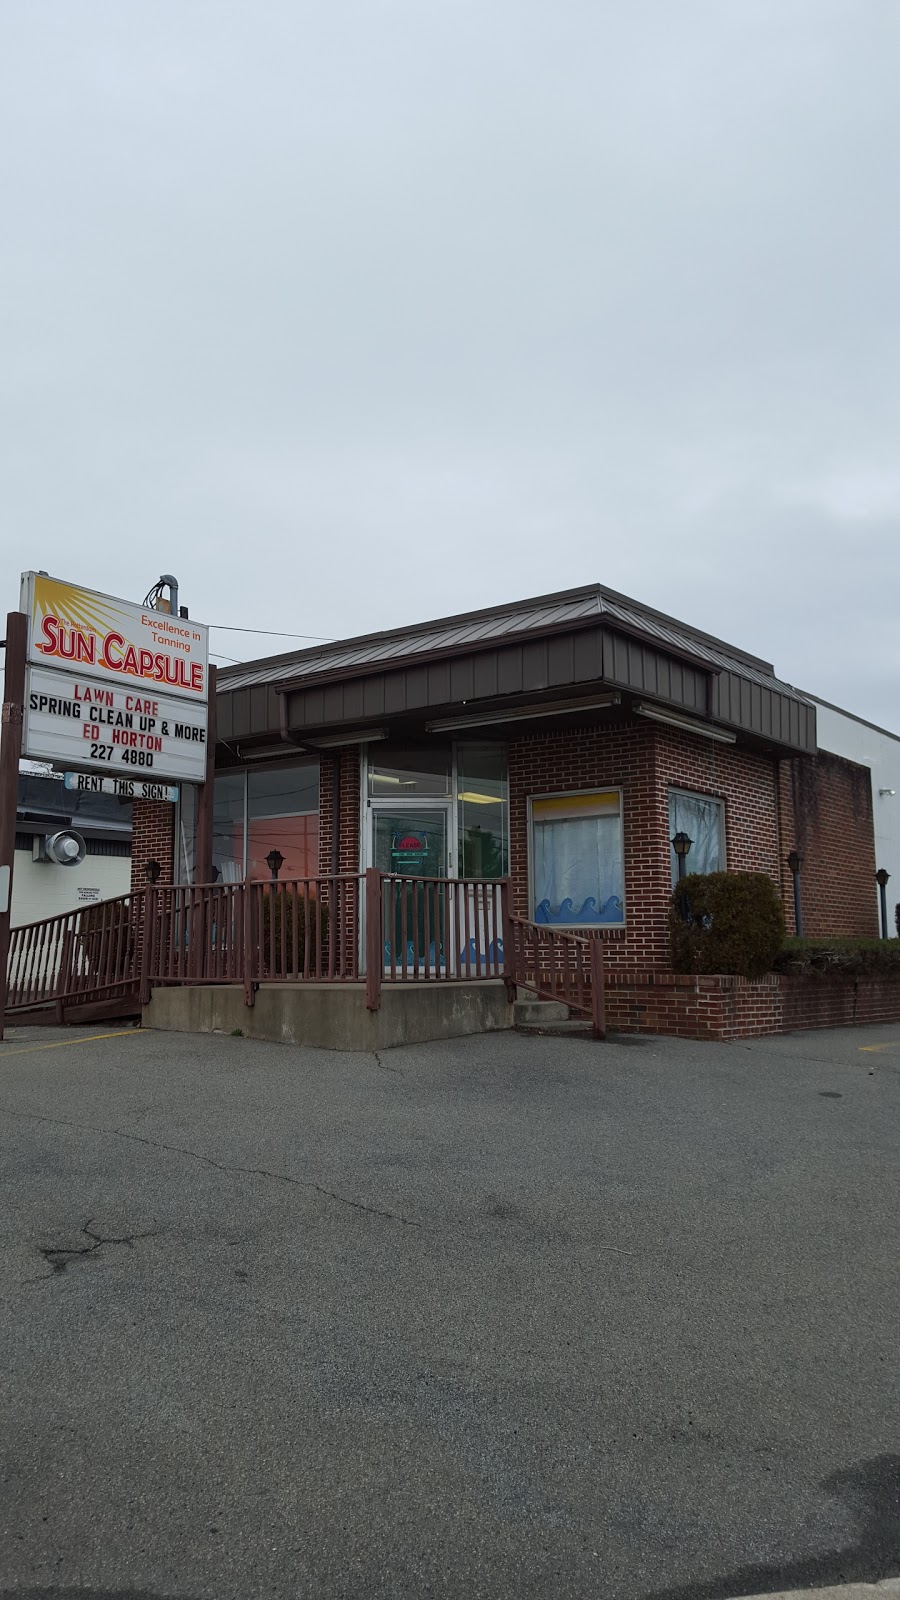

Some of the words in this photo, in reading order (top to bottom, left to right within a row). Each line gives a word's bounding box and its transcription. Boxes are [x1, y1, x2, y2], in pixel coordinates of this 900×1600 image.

[141, 615, 190, 638] Excellence
[192, 632, 201, 641] in
[152, 631, 191, 652] Tanning
[41, 614, 96, 665] SUN
[103, 631, 203, 691] CAPSULE
[74, 684, 114, 707] LAWN
[125, 696, 159, 716] CARE
[29, 693, 81, 719] SPRING
[89, 706, 133, 729] CLEAN
[139, 719, 156, 732] UP
[161, 720, 170, 736] &
[174, 723, 206, 743] MORE
[82, 723, 100, 741] ED
[112, 729, 163, 752] HORTON
[90, 743, 114, 761] 227
[121, 749, 153, 767] 4880
[77, 775, 104, 791] RENT
[113, 779, 134, 796] THIS
[141, 784, 169, 801] SIGN!
